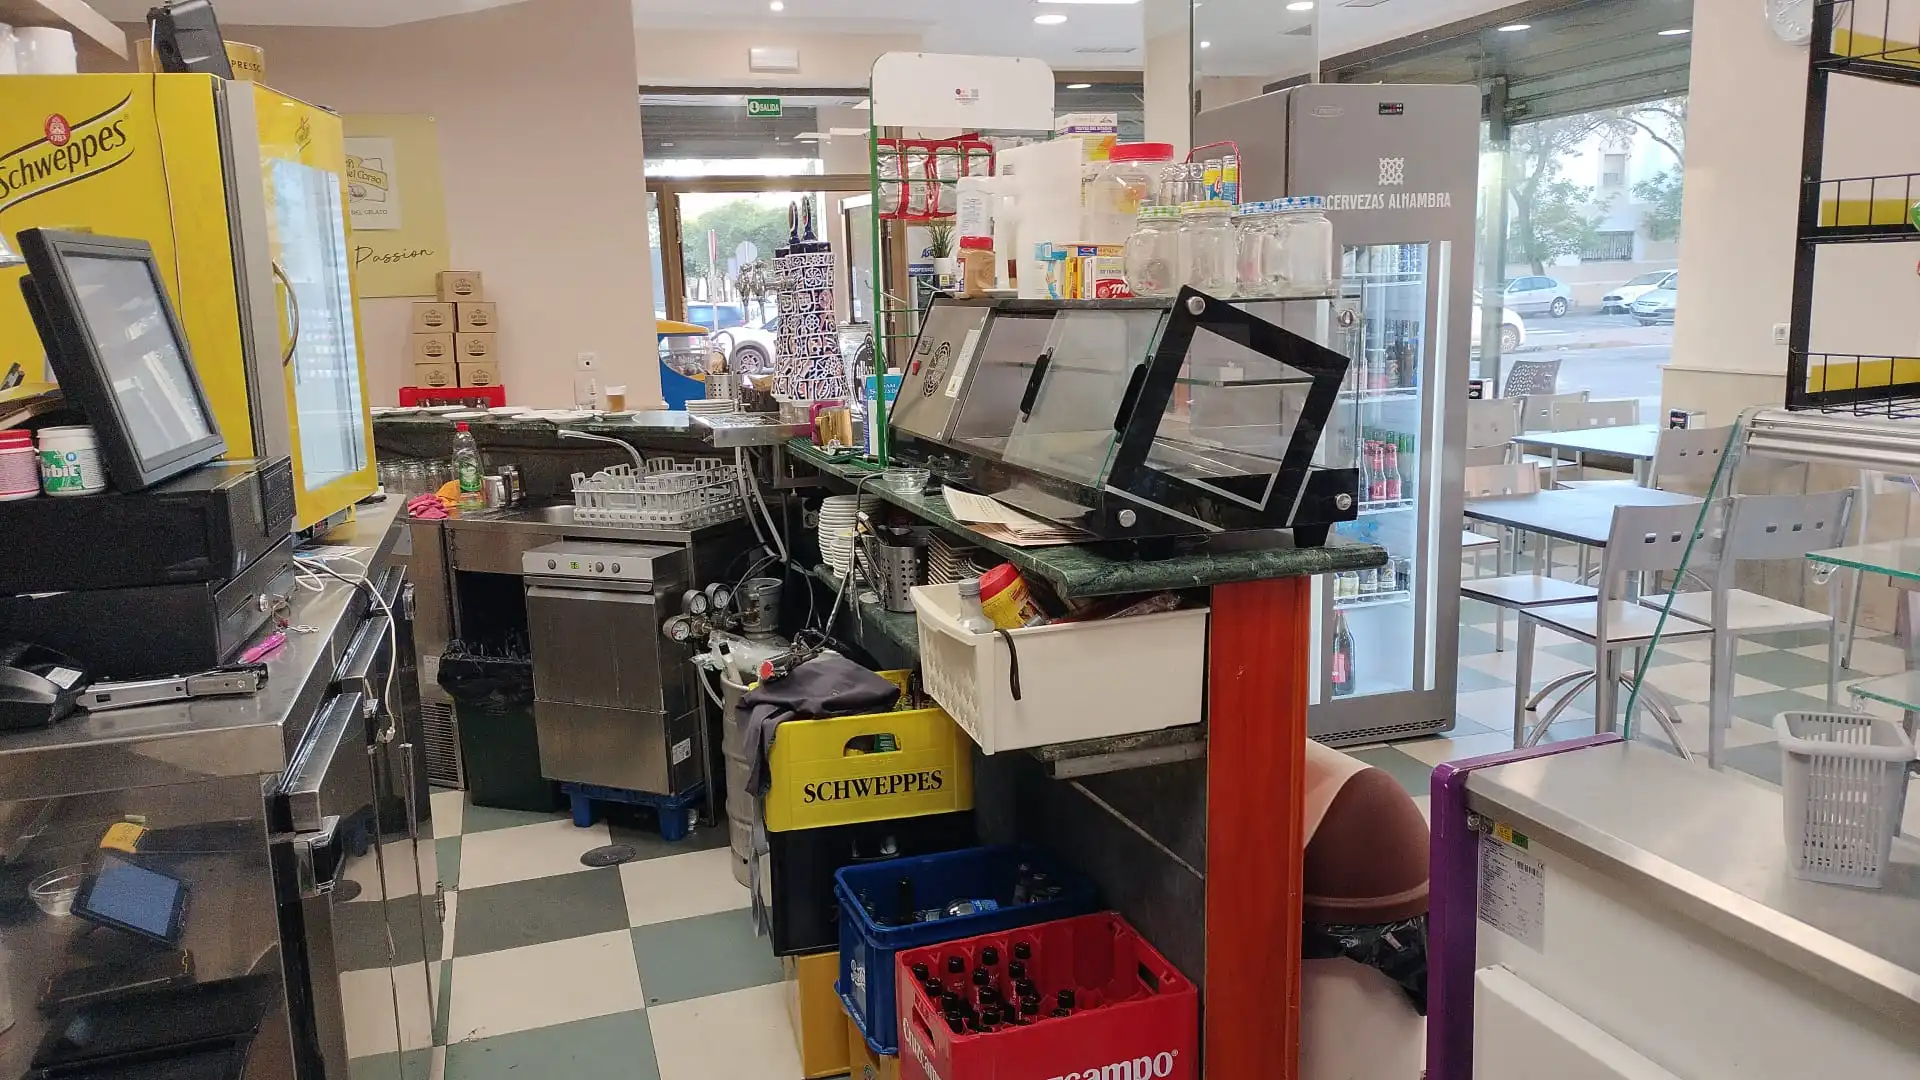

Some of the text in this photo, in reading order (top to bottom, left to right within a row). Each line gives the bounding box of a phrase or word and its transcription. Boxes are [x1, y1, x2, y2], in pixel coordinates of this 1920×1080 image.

[760, 103, 780, 113] SALIDA
[357, 170, 382, 185] Corso
[1326, 192, 1452, 211] CERVEZAS ALHAMBRA
[354, 245, 435, 270] Passion
[804, 769, 943, 804] SCHWEPPES
